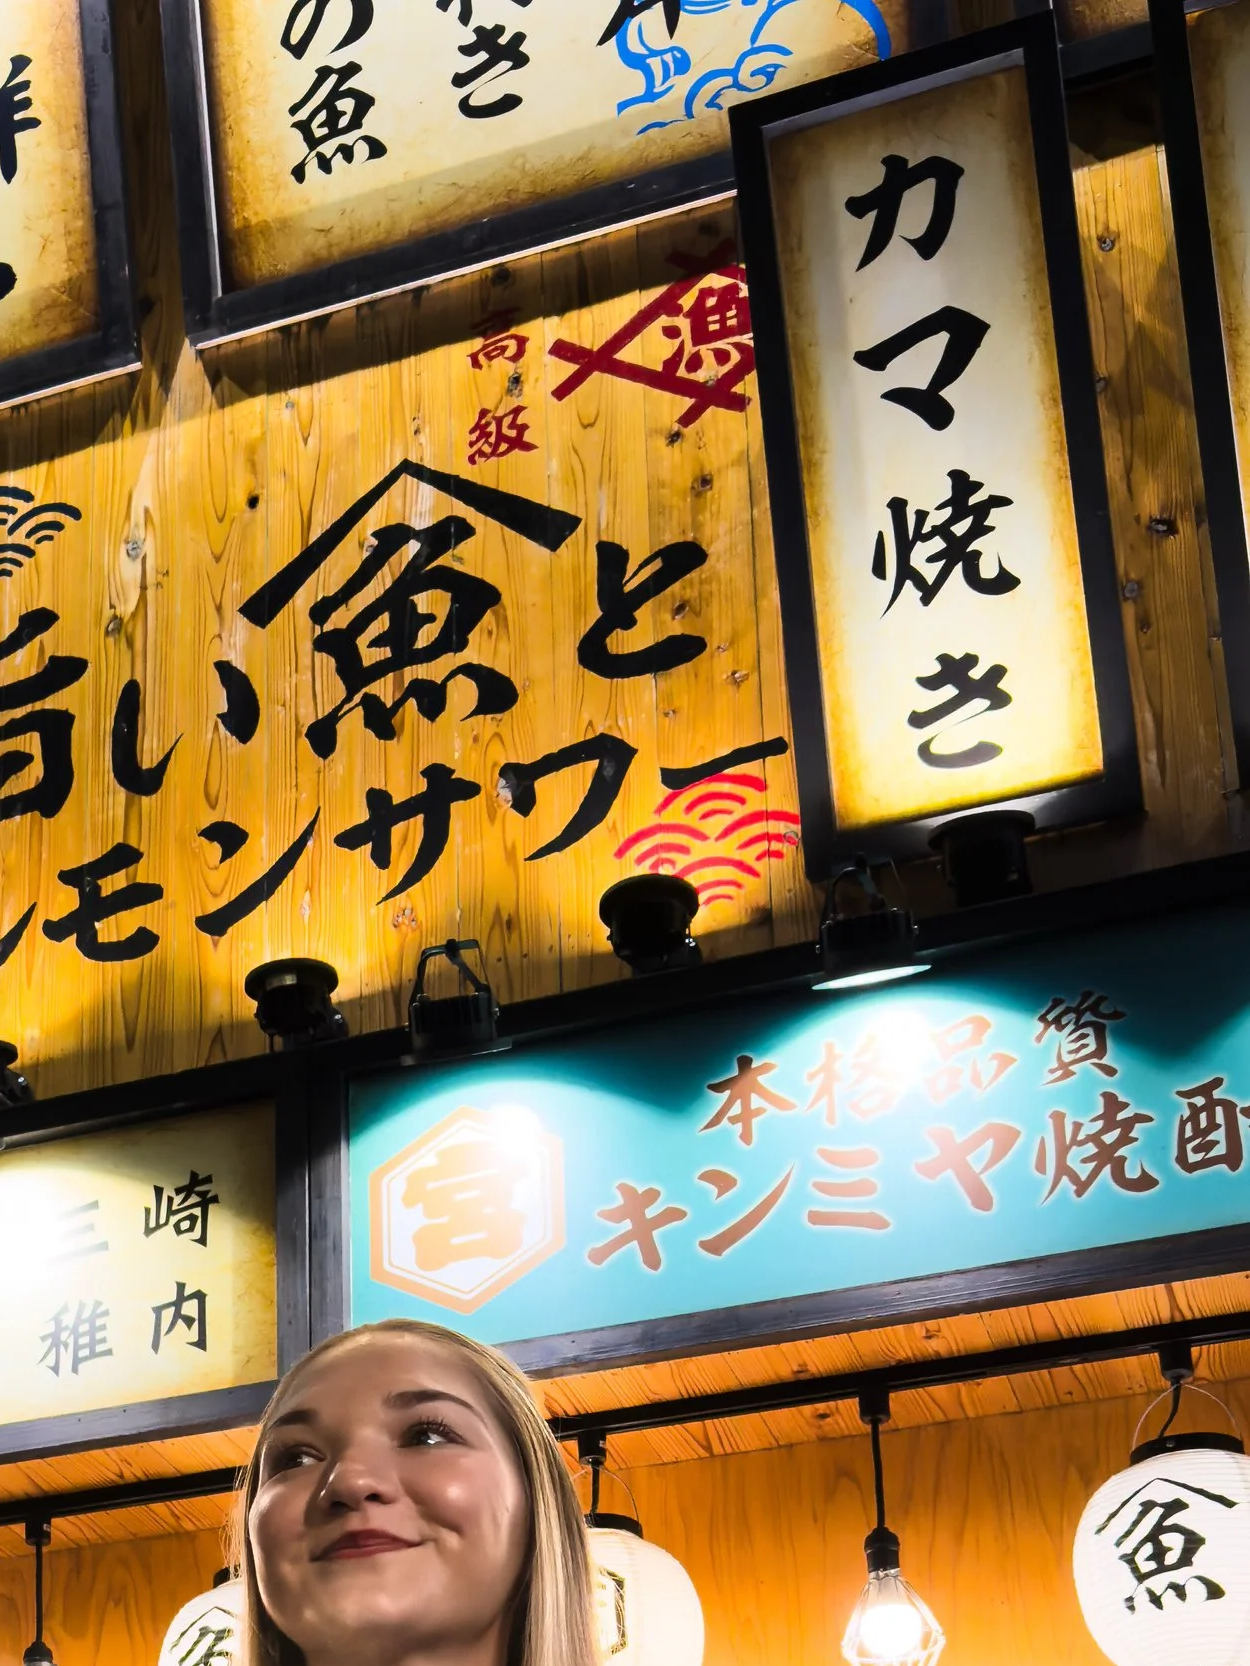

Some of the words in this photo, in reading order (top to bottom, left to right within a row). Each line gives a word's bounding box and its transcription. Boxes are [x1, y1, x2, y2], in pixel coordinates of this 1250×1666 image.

[466, 306, 539, 466] 高級
[844, 154, 1020, 768] カマ焼き
[698, 991, 1128, 1147] 本格品質
[48, 1169, 220, 1265] 三崎
[402, 1140, 530, 1273] 宮
[38, 1281, 209, 1378] 稚内
[1111, 1496, 1227, 1614] 魚
